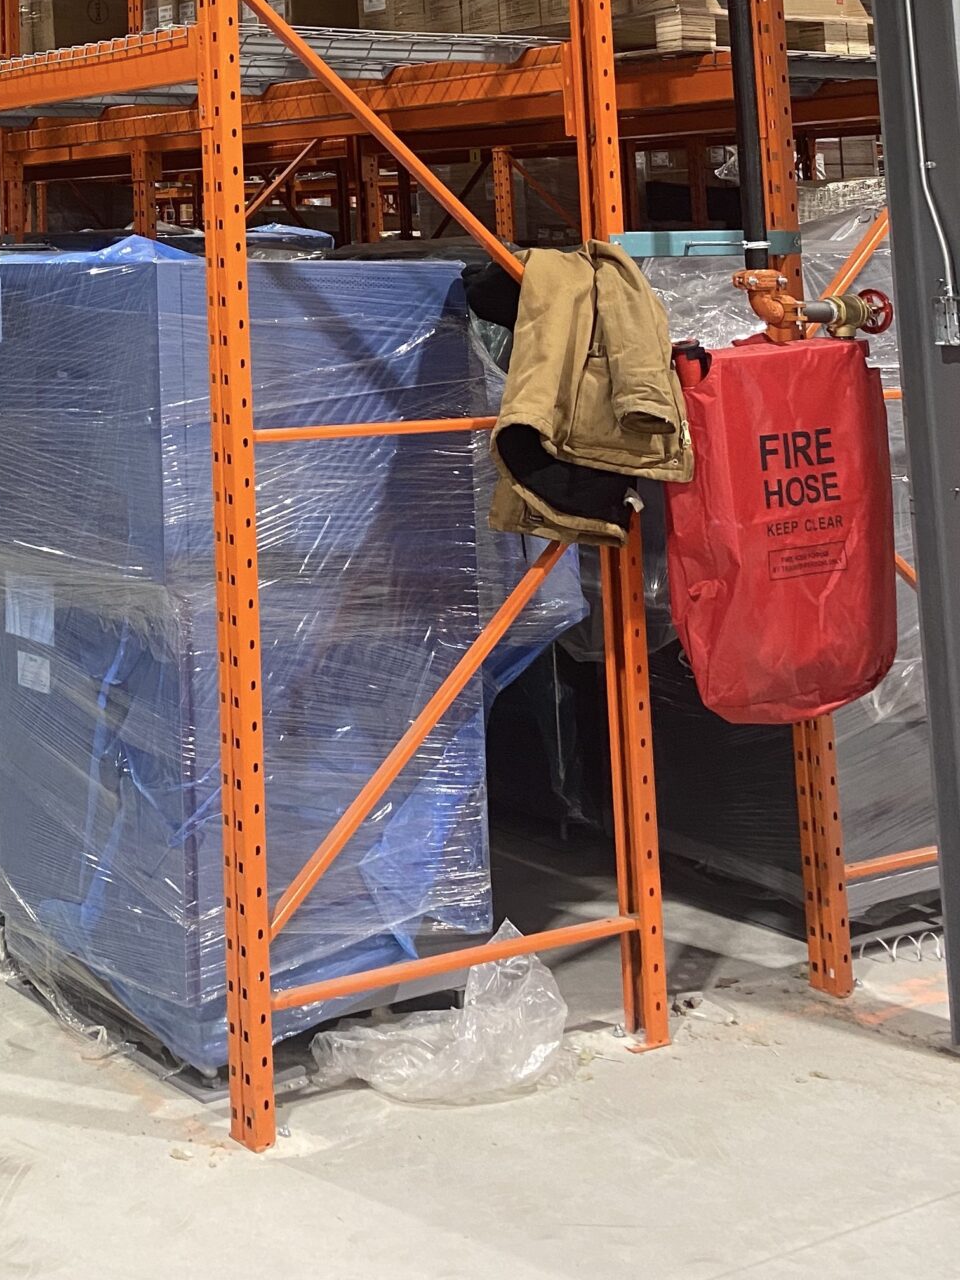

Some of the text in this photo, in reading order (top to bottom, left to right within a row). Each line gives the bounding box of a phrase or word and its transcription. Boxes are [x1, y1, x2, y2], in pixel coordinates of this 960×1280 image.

[759, 427, 836, 472] FIRE
[763, 472, 841, 509] HOSE
[767, 515, 844, 537] KEEP CLEAR
